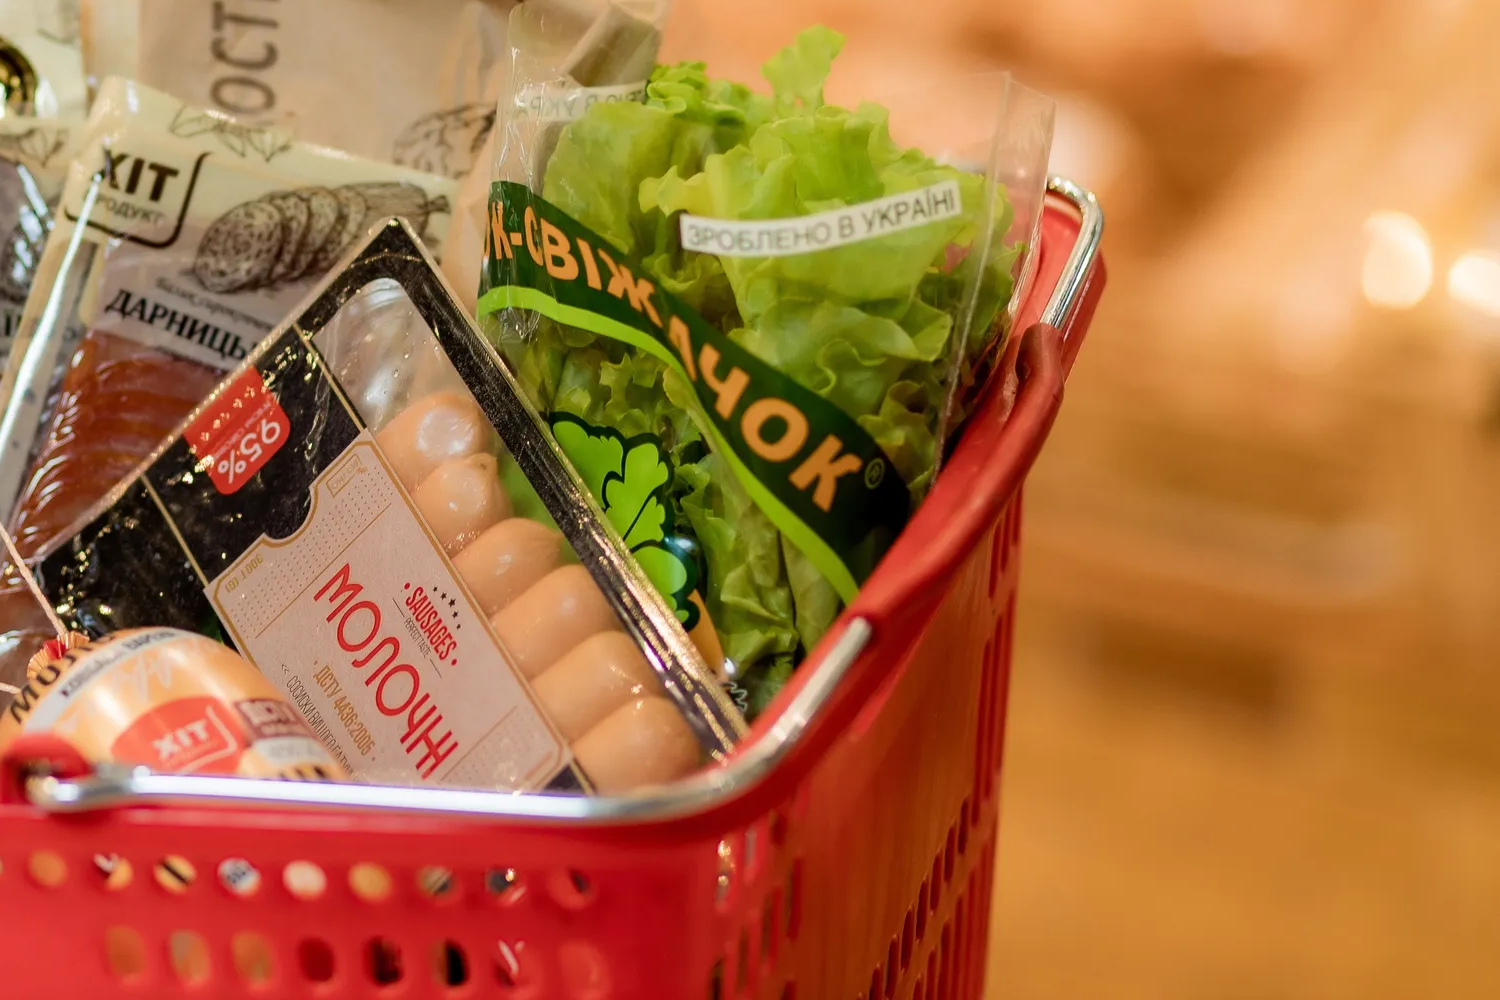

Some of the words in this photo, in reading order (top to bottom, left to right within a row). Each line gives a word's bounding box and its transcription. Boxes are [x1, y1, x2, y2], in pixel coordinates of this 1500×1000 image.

[687, 222, 831, 251] ЗРОБЛЕНО
[838, 215, 855, 239] В
[861, 187, 955, 233] УКРАЇНІ
[104, 289, 257, 362] ДАРНИЦЬ
[217, 418, 281, 485] 95%
[404, 617, 420, 644] PERFECT
[418, 638, 433, 659] TASTE
[405, 586, 458, 661] SAUSAGES
[313, 665, 343, 699] ДСТУ
[334, 695, 376, 757] 4436:2005
